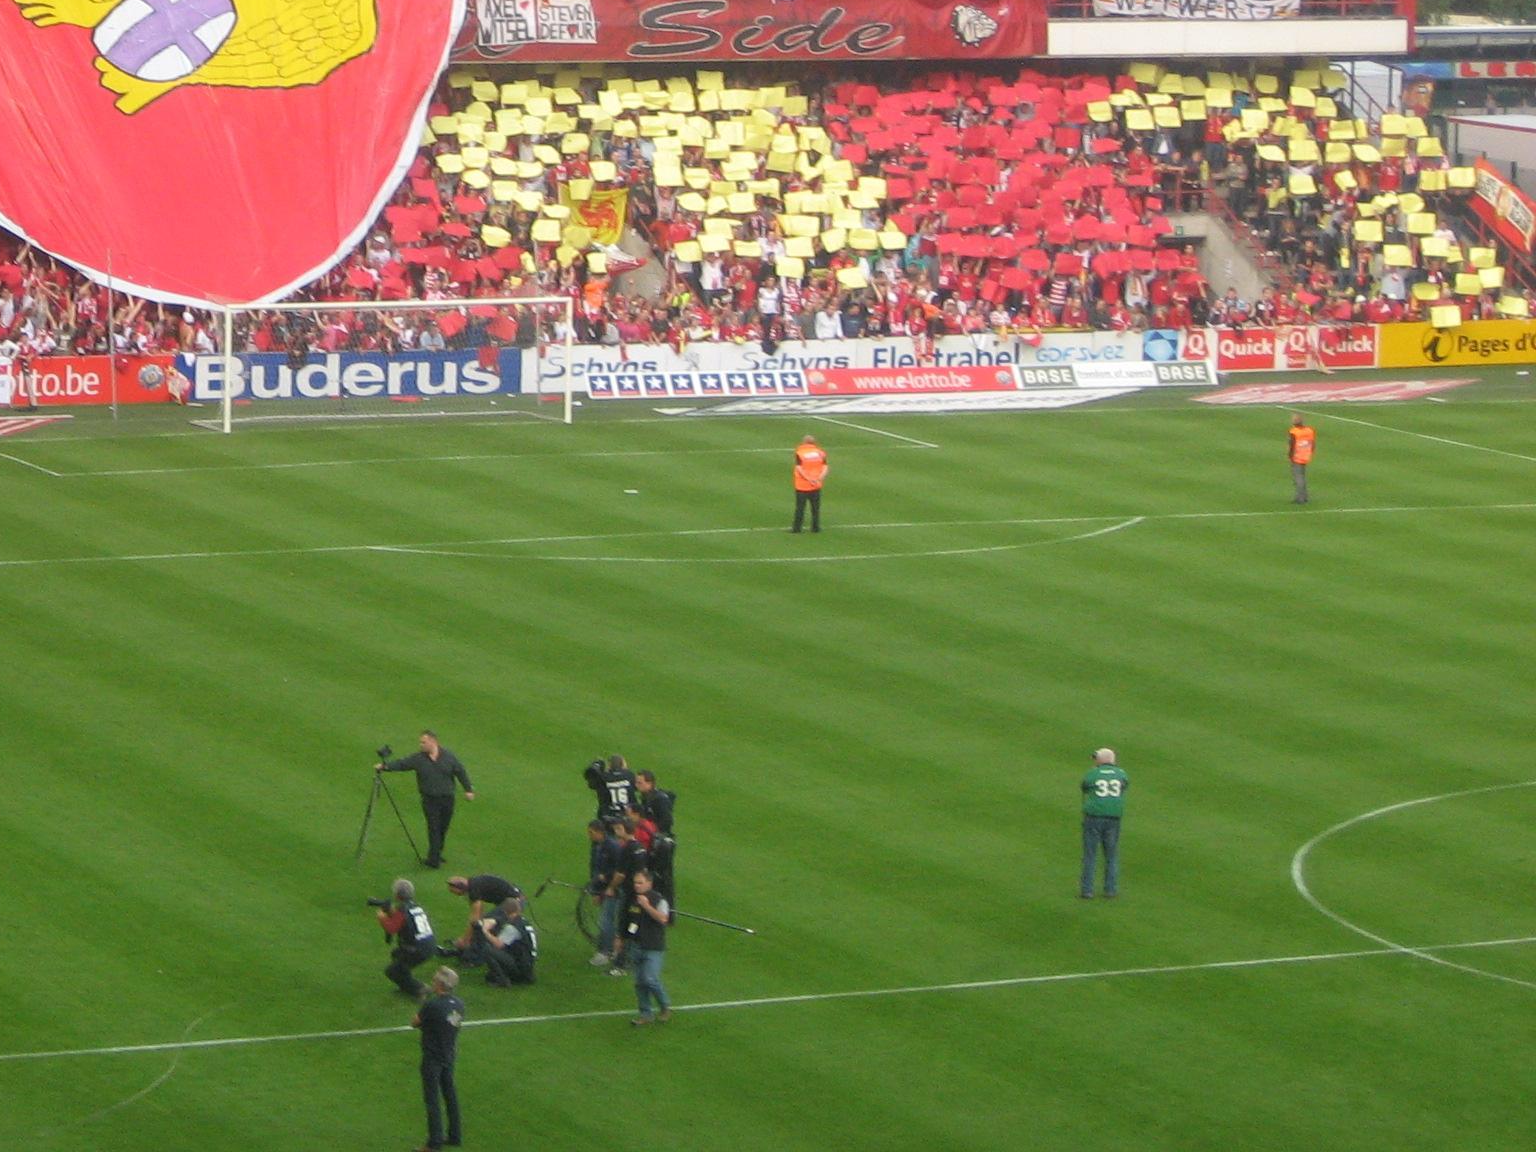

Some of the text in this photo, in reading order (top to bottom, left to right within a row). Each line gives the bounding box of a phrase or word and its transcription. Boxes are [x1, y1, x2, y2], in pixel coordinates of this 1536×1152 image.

[539, 3, 594, 22] STEVEN
[479, 19, 535, 44] WITSEL
[627, 0, 904, 56] Side
[873, 343, 1020, 368] Eletrabel
[1220, 337, 1276, 358] Quick
[1458, 335, 1510, 356] Pages
[196, 354, 501, 400] Buderus
[853, 371, 972, 390] www.e-lotto.be
[1023, 368, 1074, 386] BASE
[1159, 363, 1208, 382] BASE
[1095, 779, 1122, 798] 33
